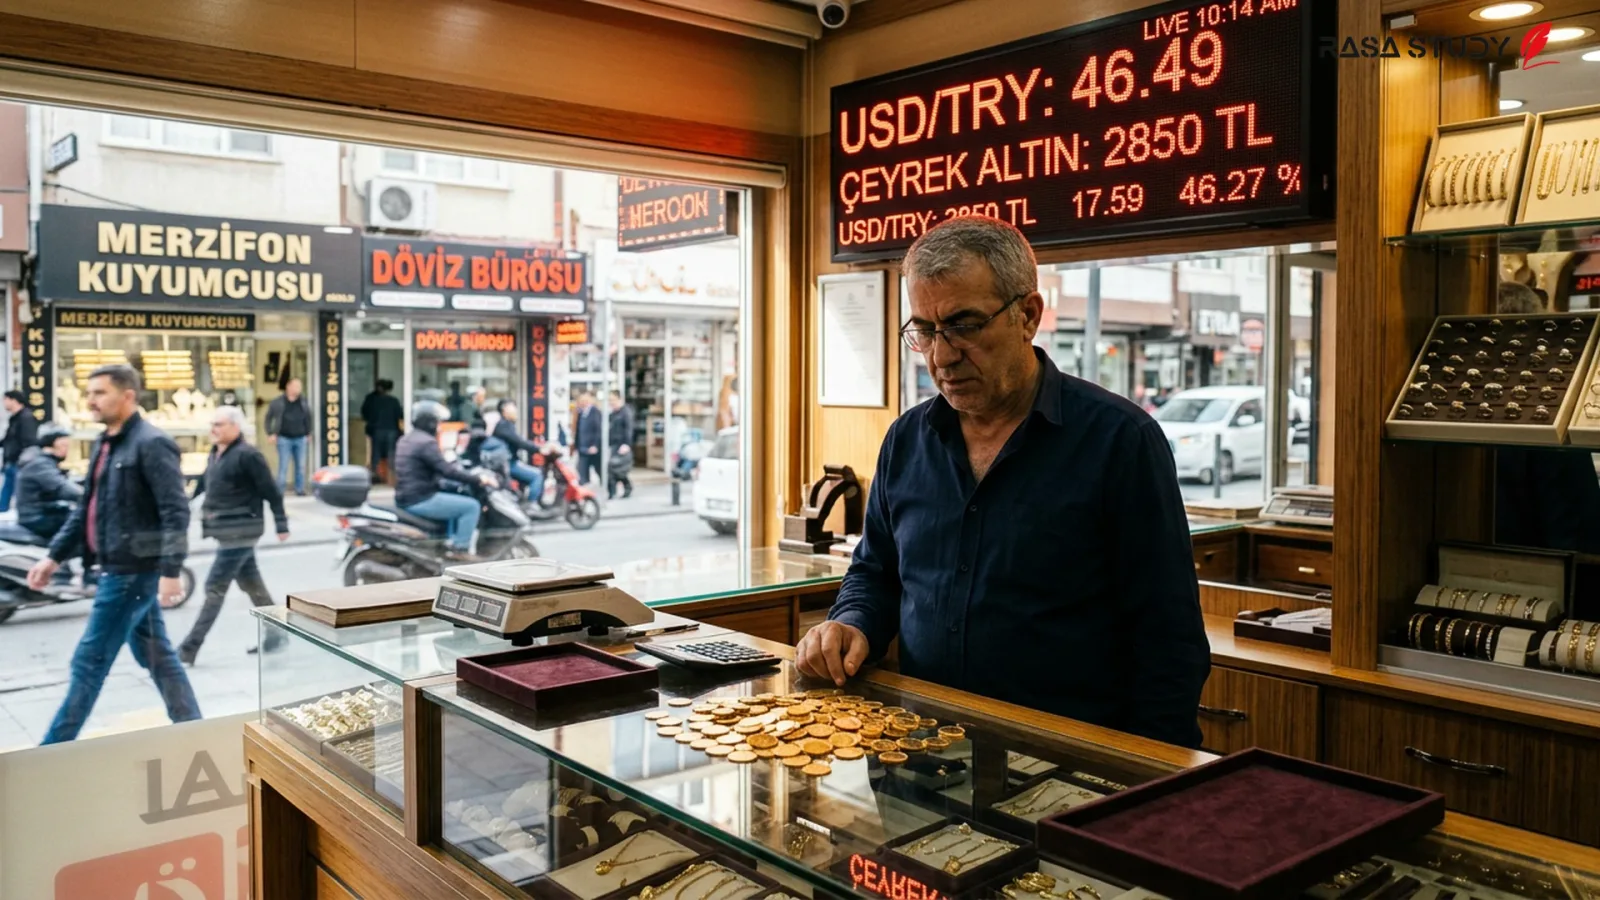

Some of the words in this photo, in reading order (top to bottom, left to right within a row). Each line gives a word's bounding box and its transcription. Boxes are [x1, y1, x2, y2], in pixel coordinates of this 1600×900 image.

[1144, 11, 1189, 41] LIVE
[1197, 0, 1254, 27] 10:14
[841, 68, 1053, 154] USD/TRY:
[1072, 30, 1223, 109] 46.49
[840, 152, 969, 214] ÇEYREK
[976, 133, 1090, 186] ALTIN:
[1103, 113, 1202, 168] 2850
[1216, 103, 1273, 150] TL
[1006, 198, 1037, 227] TL
[1072, 184, 1144, 219] 17.59
[1179, 167, 1266, 205] 46.27
[1277, 163, 1301, 195] %
[98, 222, 312, 265] MERZİFON
[78, 260, 323, 302] KUYUMCUSU
[372, 243, 465, 288] DÖVİZ
[471, 250, 583, 295] BÜROSU
[60, 310, 146, 327] MERZİFON
[152, 313, 248, 329] KUYUMCUSU
